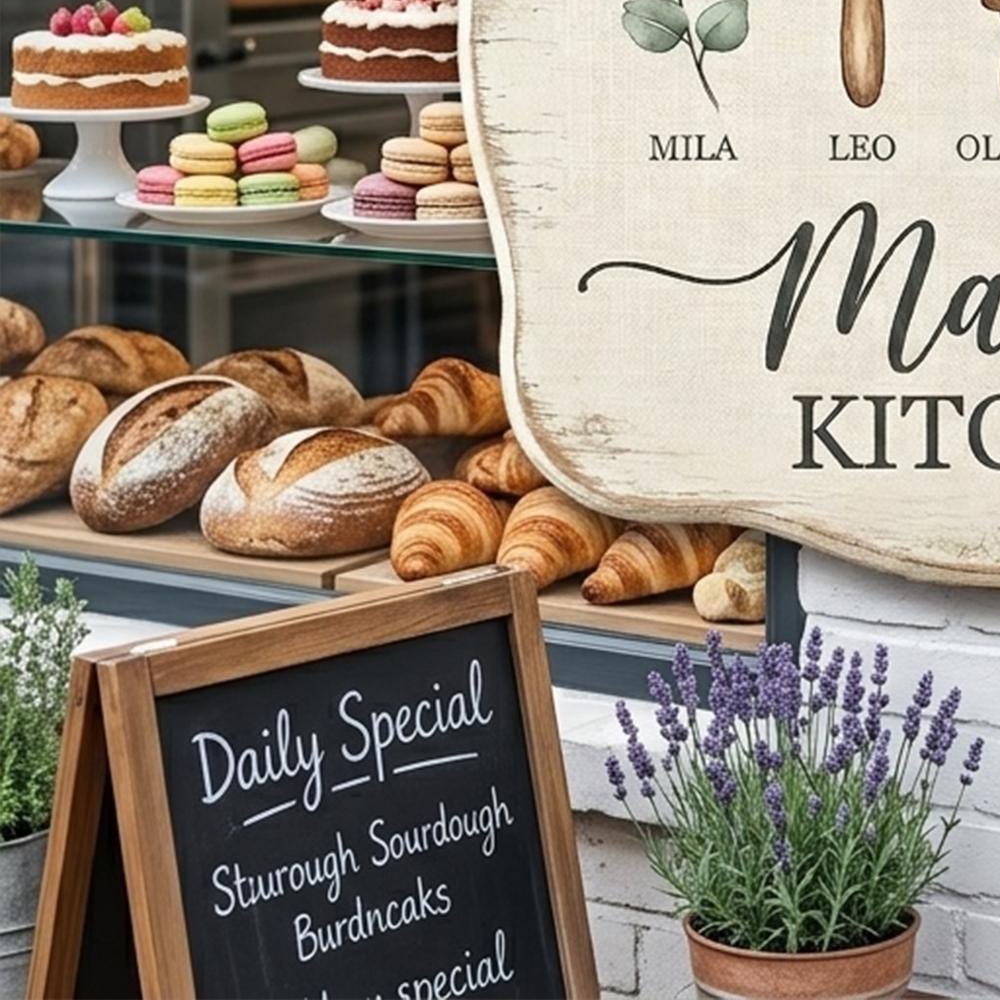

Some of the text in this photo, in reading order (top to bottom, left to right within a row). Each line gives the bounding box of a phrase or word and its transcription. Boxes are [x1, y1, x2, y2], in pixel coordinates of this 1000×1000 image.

[649, 134, 738, 161] MILA
[829, 134, 896, 162] LEO
[191, 659, 493, 812] Daily Special
[369, 786, 514, 867] Sourdough
